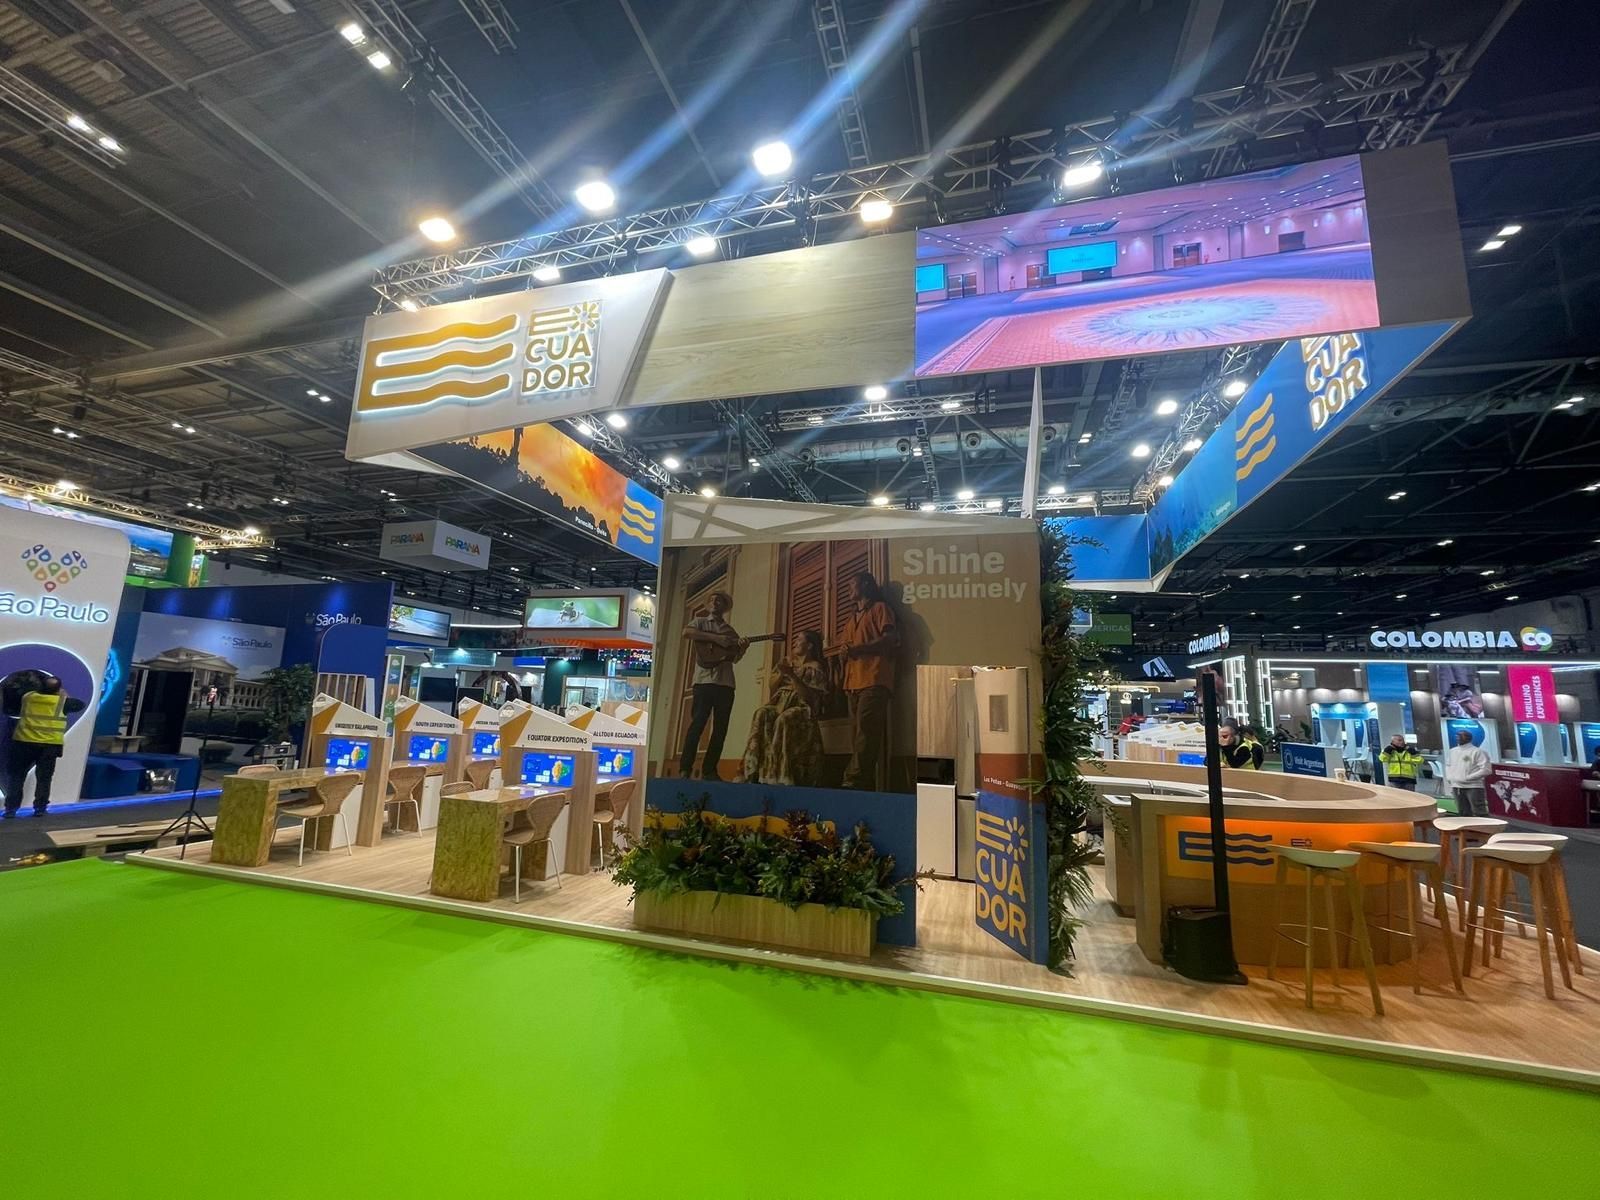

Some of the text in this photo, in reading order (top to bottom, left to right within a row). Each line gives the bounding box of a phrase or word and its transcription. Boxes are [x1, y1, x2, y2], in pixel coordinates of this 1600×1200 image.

[903, 545, 1005, 576] Shine
[902, 577, 1027, 604] genuinely
[0, 593, 109, 623] ão Paulo
[316, 614, 335, 626] São
[1091, 624, 1130, 632] MERICAS
[232, 637, 273, 648] São Paulo
[1189, 632, 1221, 655] COLOMBIA
[1370, 630, 1551, 648] COLOMBIA CO
[527, 734, 588, 744] EQUATOR EXPEDITIONS
